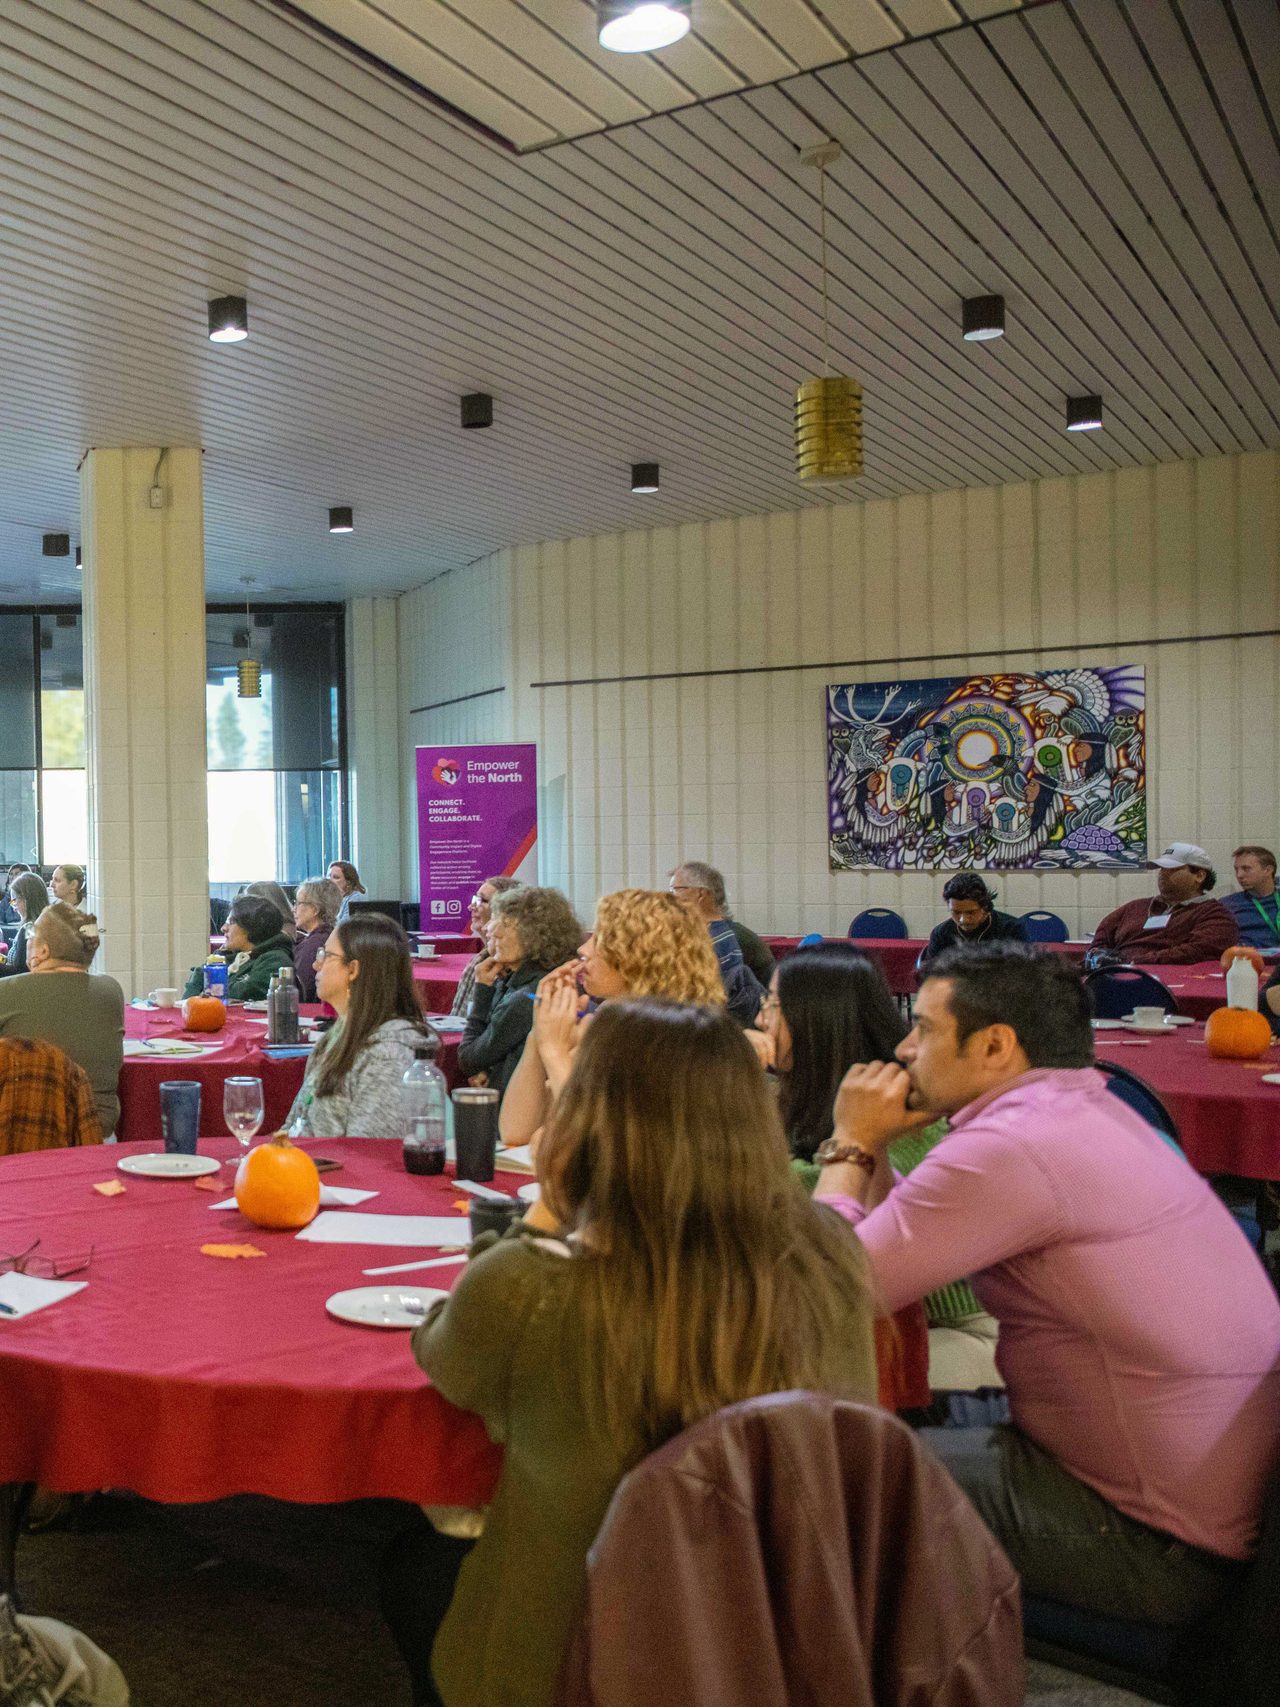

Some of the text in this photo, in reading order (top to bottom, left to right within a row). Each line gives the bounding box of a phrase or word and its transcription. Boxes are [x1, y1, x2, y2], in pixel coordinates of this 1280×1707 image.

[467, 760, 520, 772] Empower
[467, 772, 523, 784] the North
[428, 807, 461, 815] ENGAGE.
[428, 814, 483, 823] COLLABORATE.
